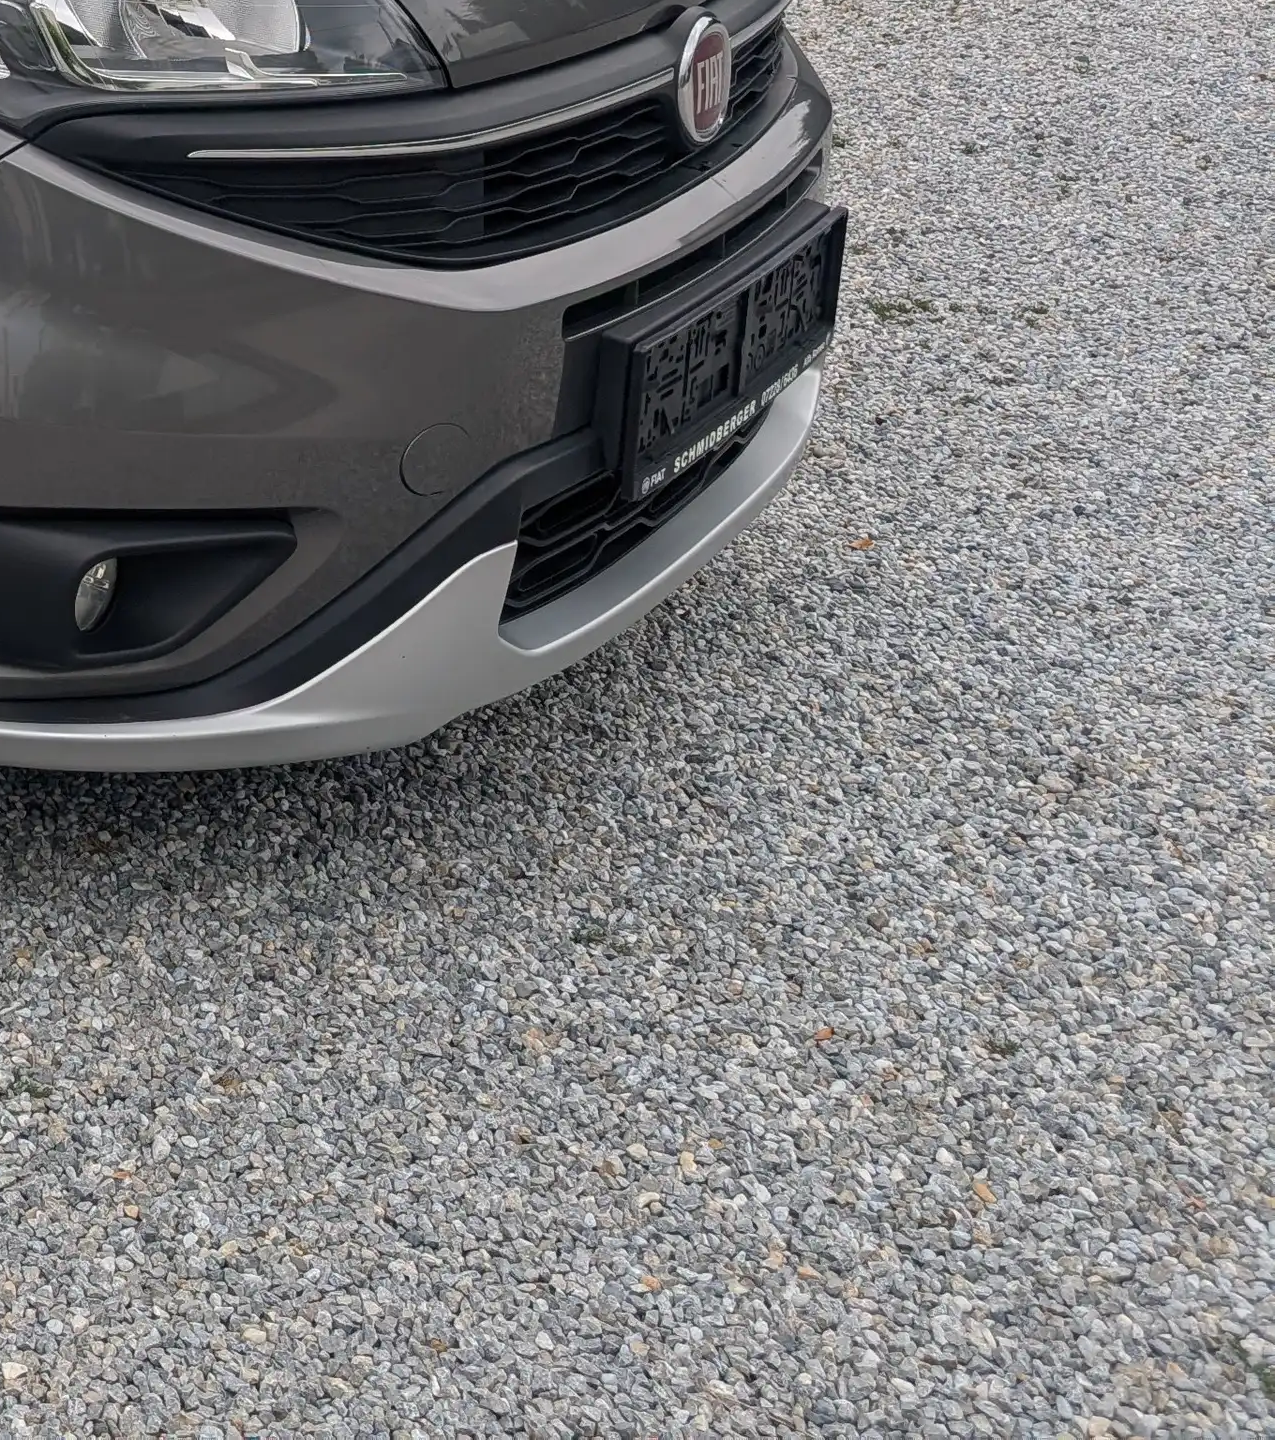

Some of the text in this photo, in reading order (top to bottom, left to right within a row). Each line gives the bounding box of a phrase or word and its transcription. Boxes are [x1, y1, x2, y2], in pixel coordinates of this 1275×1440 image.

[697, 51, 724, 115] FIAT
[650, 468, 666, 487] FIAT
[673, 399, 757, 473] SCHMIDBERGER
